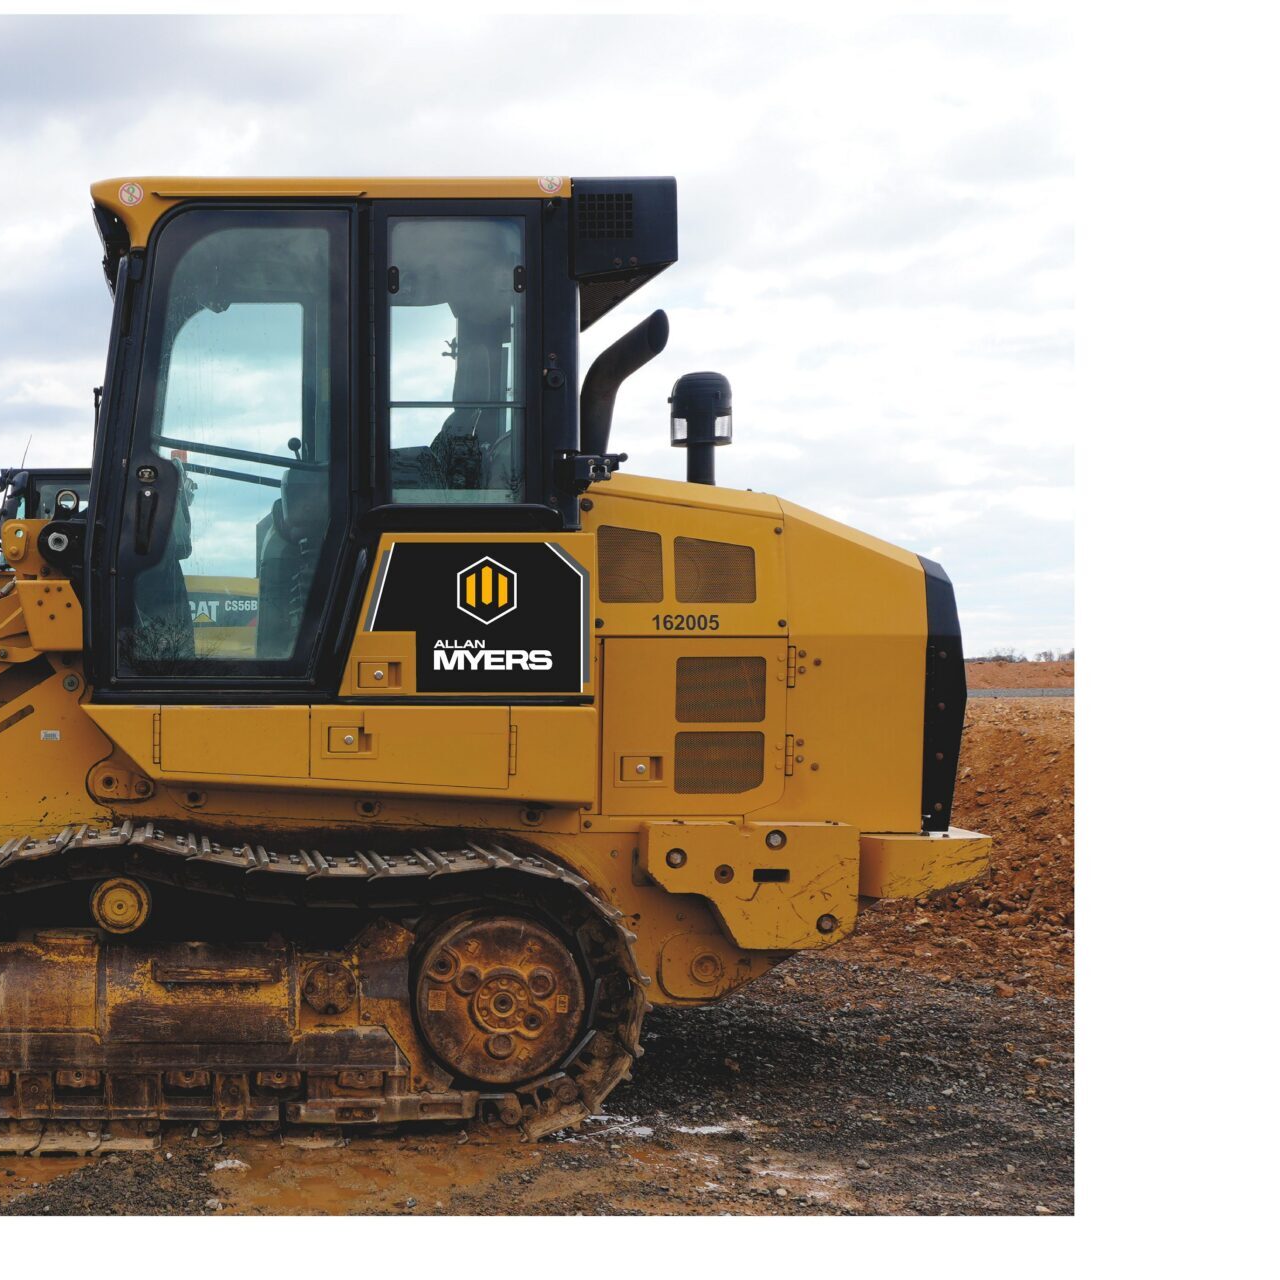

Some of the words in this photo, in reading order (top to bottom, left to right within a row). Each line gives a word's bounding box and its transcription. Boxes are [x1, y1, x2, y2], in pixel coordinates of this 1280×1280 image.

[224, 600, 258, 612] CS56B
[652, 614, 720, 631] 162005
[433, 639, 486, 649] ALLAN
[433, 649, 553, 671] MYERS
